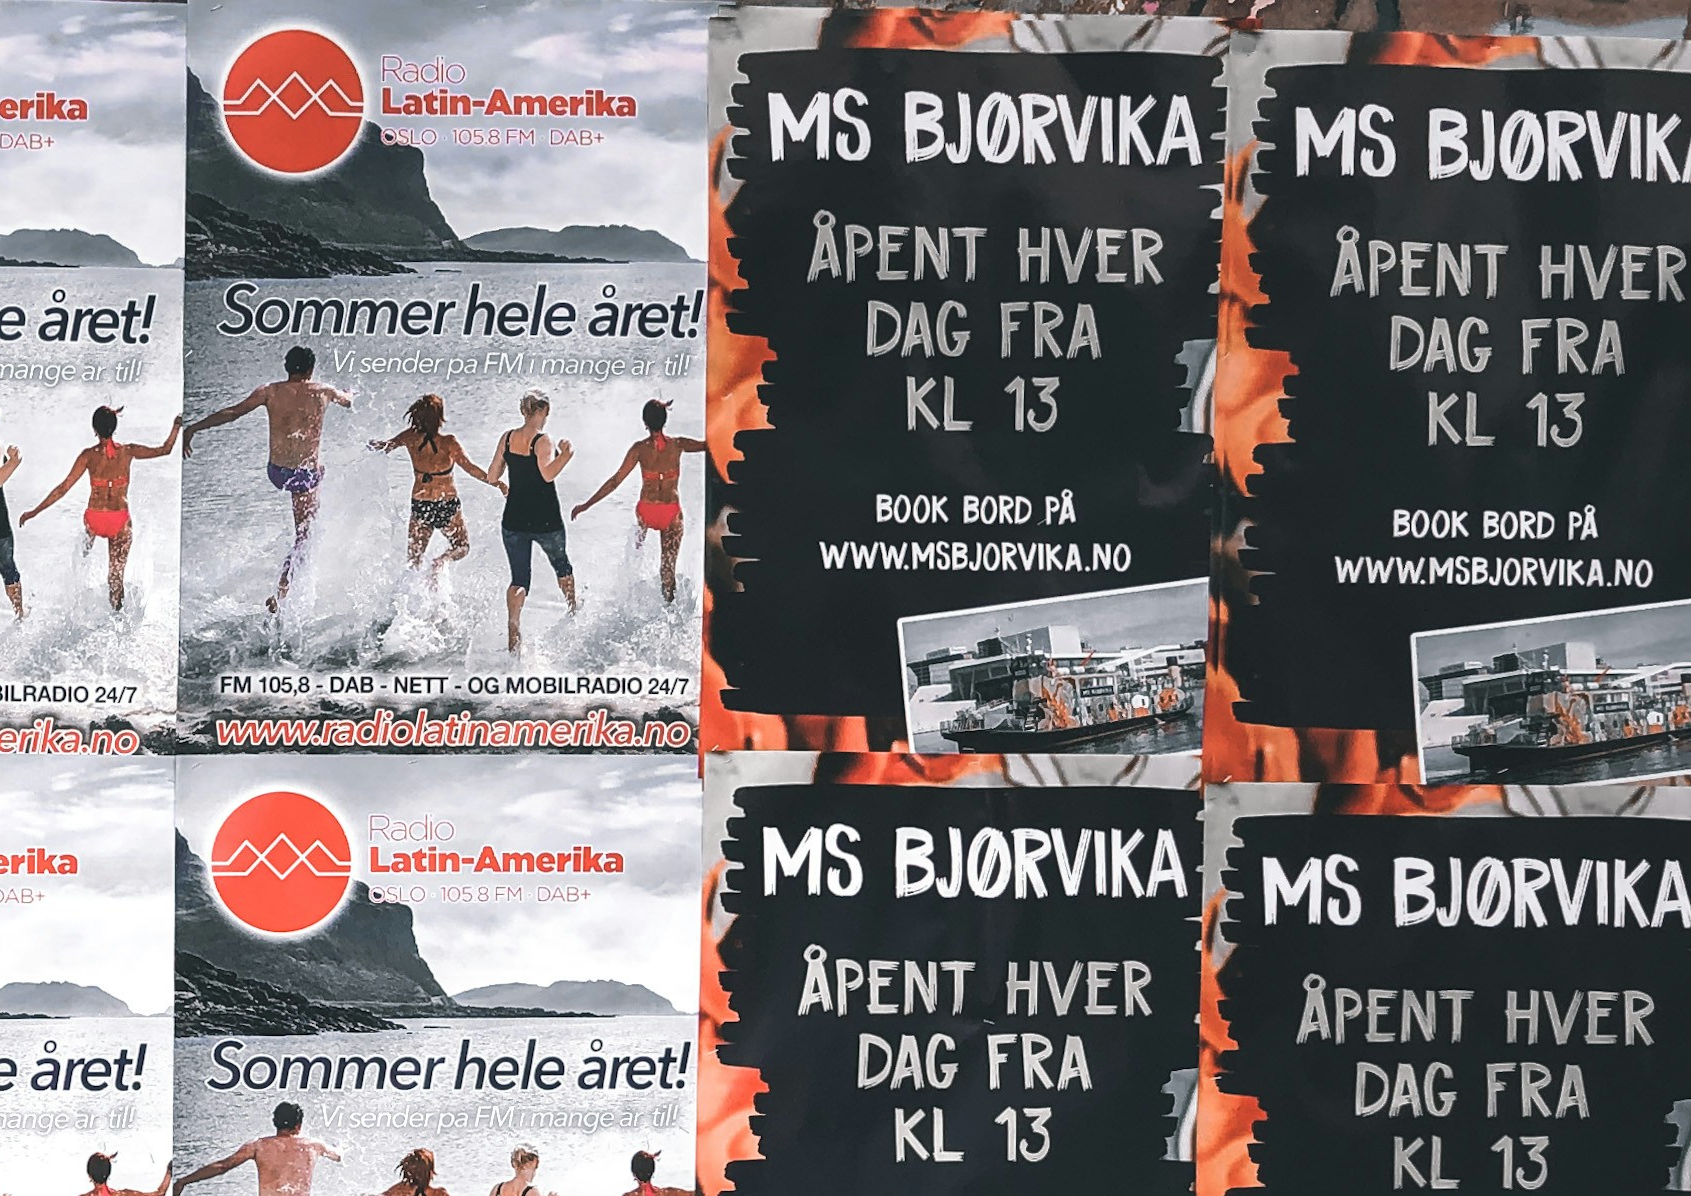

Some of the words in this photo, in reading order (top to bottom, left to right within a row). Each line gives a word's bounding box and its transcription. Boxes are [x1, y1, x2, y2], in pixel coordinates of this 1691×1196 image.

[768, 87, 871, 163] MS
[904, 90, 1203, 166] BJØRVIKA
[1295, 104, 1397, 178] MS
[1428, 108, 1691, 182] BJØRVIK
[807, 209, 988, 284] ÅPENT
[1017, 227, 1165, 285] HVER
[37, 289, 158, 345] året!
[866, 300, 971, 359] DAG
[1000, 302, 1102, 360] FRA
[115, 359, 143, 382] til!
[906, 376, 974, 432] KL
[1004, 376, 1061, 433] 13
[876, 493, 950, 524] BOOK
[962, 495, 1033, 525] BORD
[1044, 489, 1076, 526] PÅ
[819, 541, 1132, 572] WWW.MSBJORVIKA.NO
[1334, 556, 1654, 588] WWW.MSBJORVIKA.NO
[94, 685, 137, 704] 24/7
